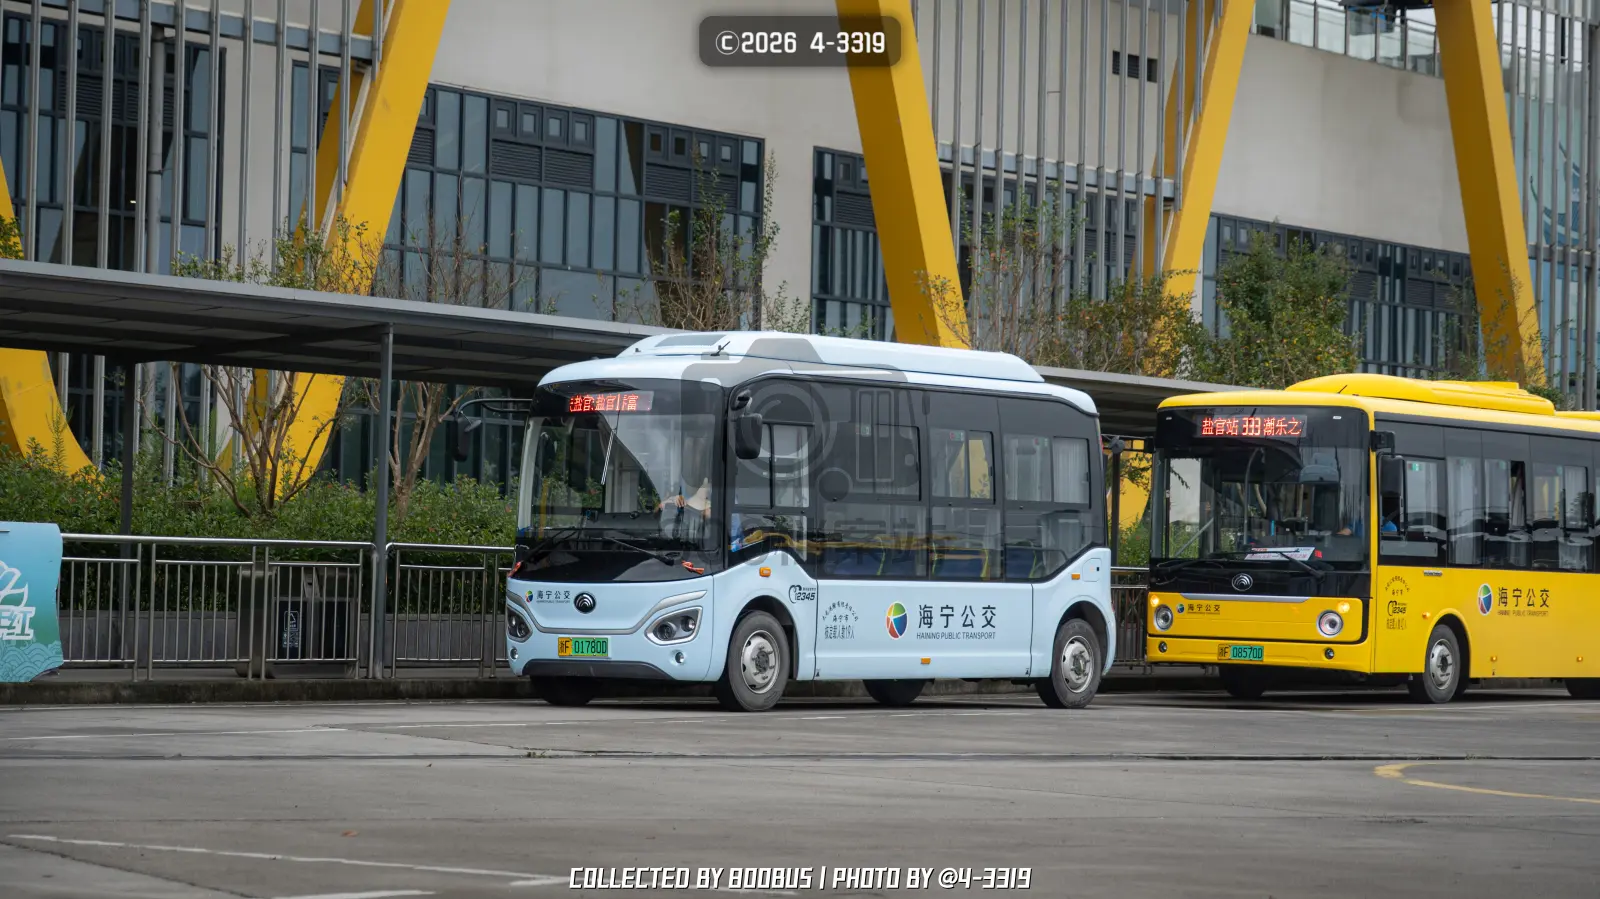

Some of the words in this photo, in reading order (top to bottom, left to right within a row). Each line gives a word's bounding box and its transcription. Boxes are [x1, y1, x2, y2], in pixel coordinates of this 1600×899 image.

[1242, 417, 1261, 435] 333
[536, 590, 571, 600] 海宁公交
[795, 592, 816, 601] 12345
[1497, 587, 1550, 607] 海宁公交
[918, 604, 996, 628] 海宁公交
